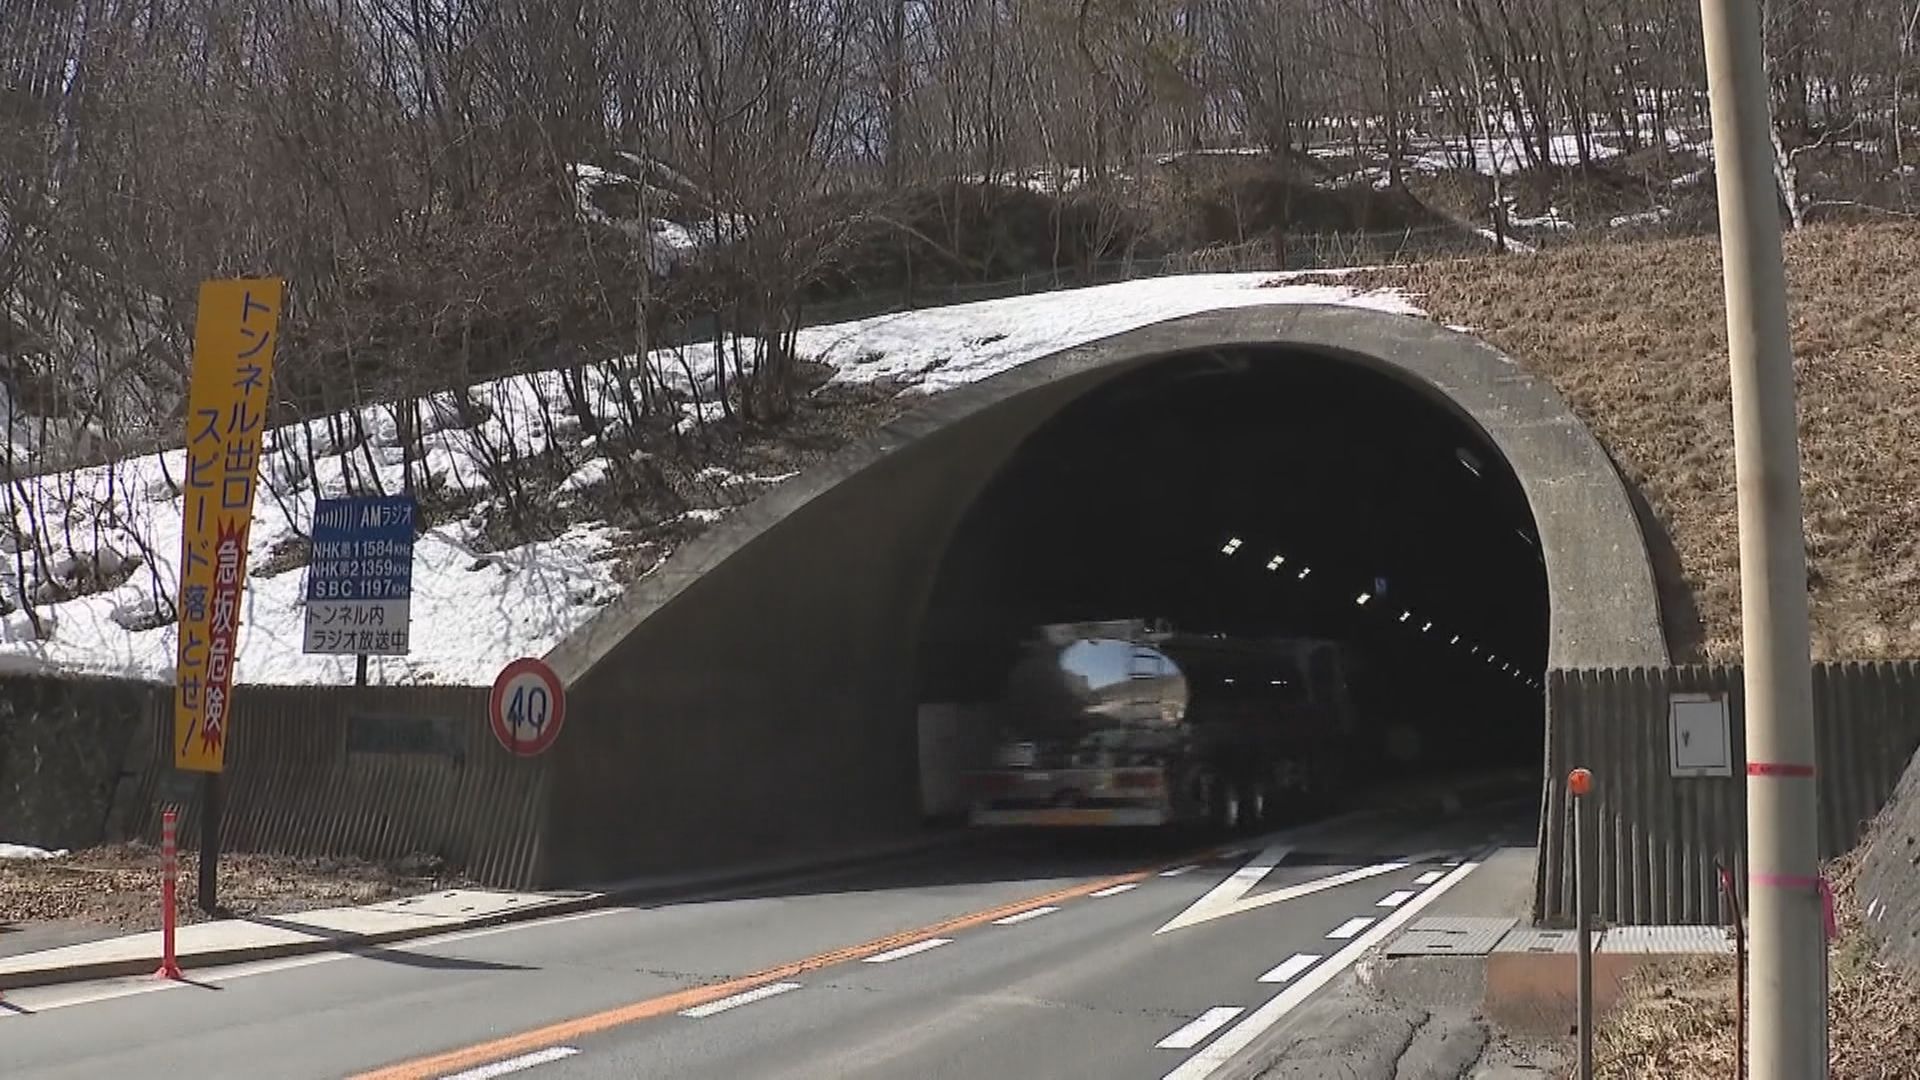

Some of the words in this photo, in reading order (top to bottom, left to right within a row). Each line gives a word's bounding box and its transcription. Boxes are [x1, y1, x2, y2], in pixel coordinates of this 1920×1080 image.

[222, 291, 270, 509] トンネル出口
[360, 504, 413, 528] AMラジオ
[315, 580, 353, 598] SBC
[309, 604, 385, 626] トンネル内
[202, 540, 239, 732] 急坂危険
[312, 629, 407, 652] ラジオ放送中
[507, 686, 547, 728] 40
